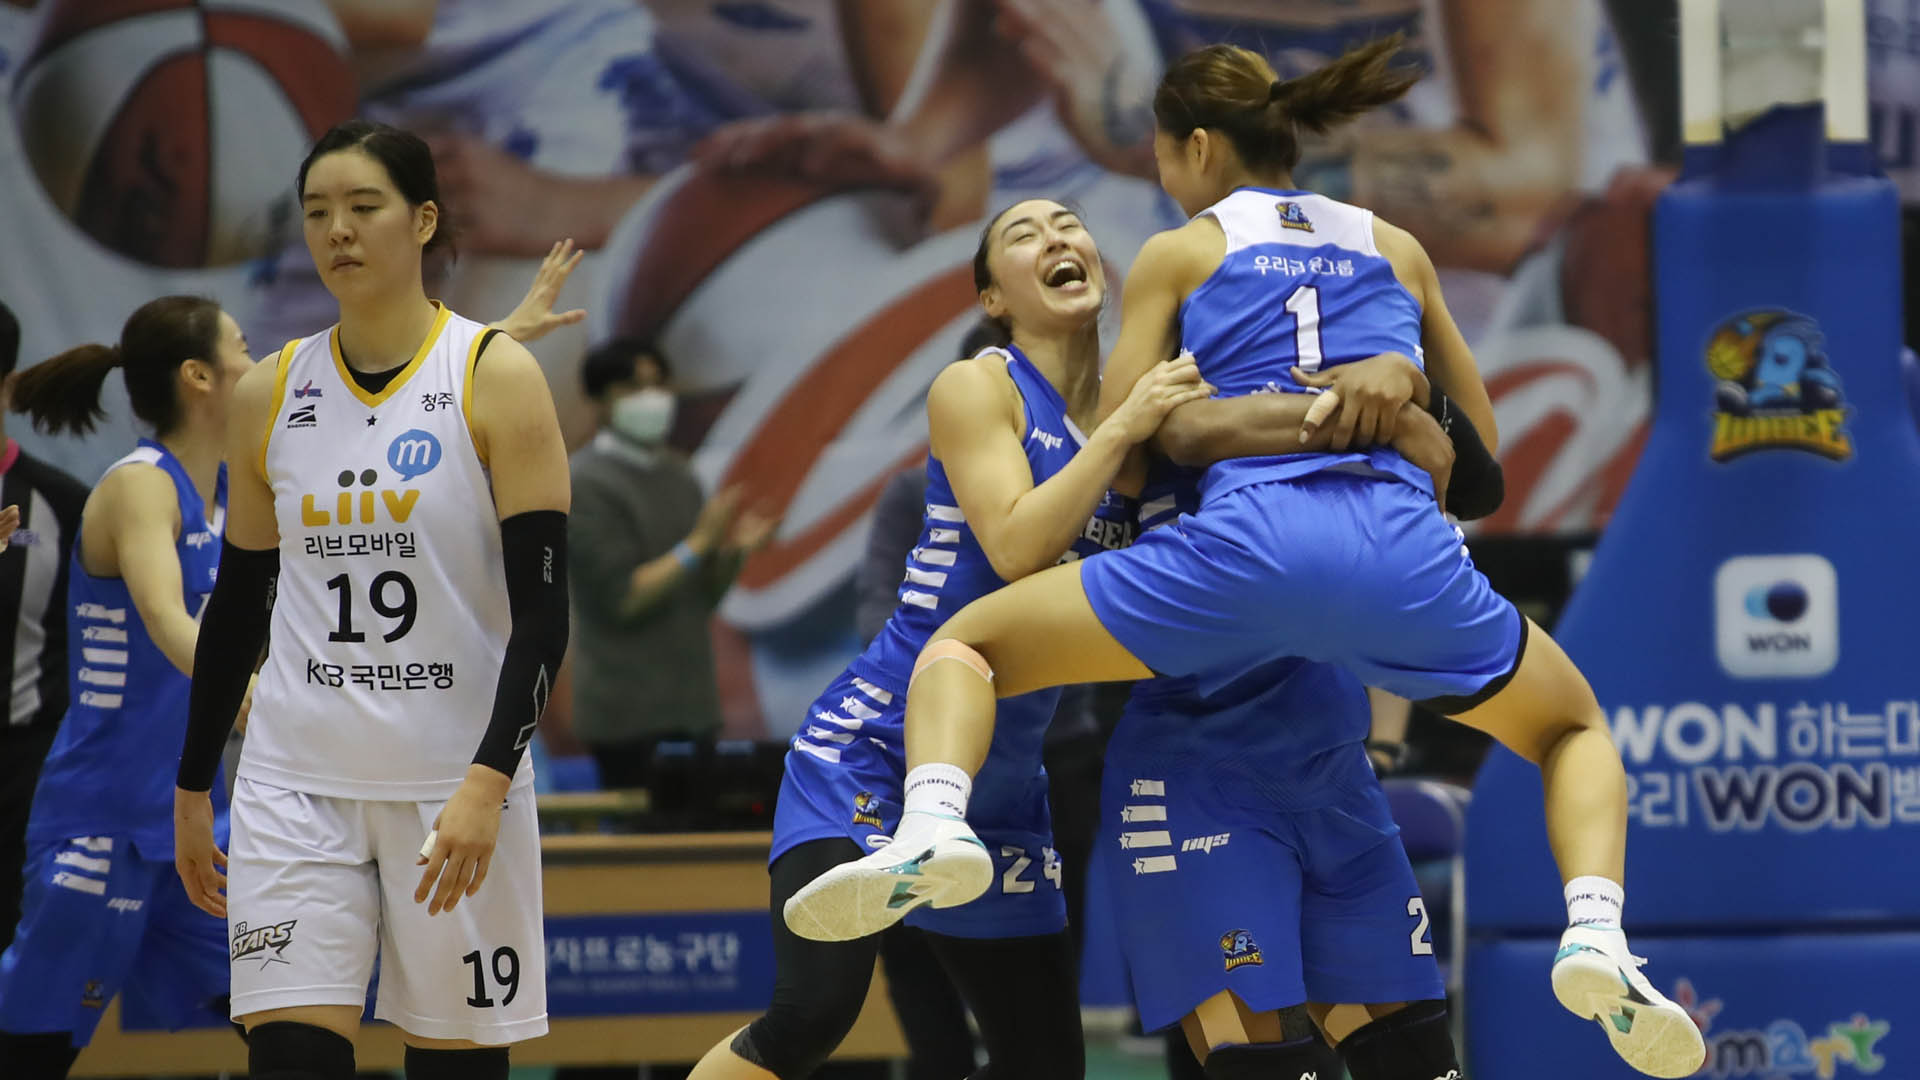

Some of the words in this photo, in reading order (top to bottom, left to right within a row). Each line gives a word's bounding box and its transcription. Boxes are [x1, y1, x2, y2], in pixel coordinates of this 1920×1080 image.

[1284, 286, 1323, 373] 1
[421, 393, 453, 411] 청주
[304, 532, 417, 559] 리브모바일
[543, 546, 553, 584] 2XU
[326, 570, 418, 644] 19
[1746, 633, 1811, 654] WON
[231, 920, 298, 961] STARS
[1407, 897, 1433, 955] 2
[545, 933, 739, 973] 자프로농구단
[462, 946, 520, 1008] 19
[1704, 1016, 1891, 1080] mart
